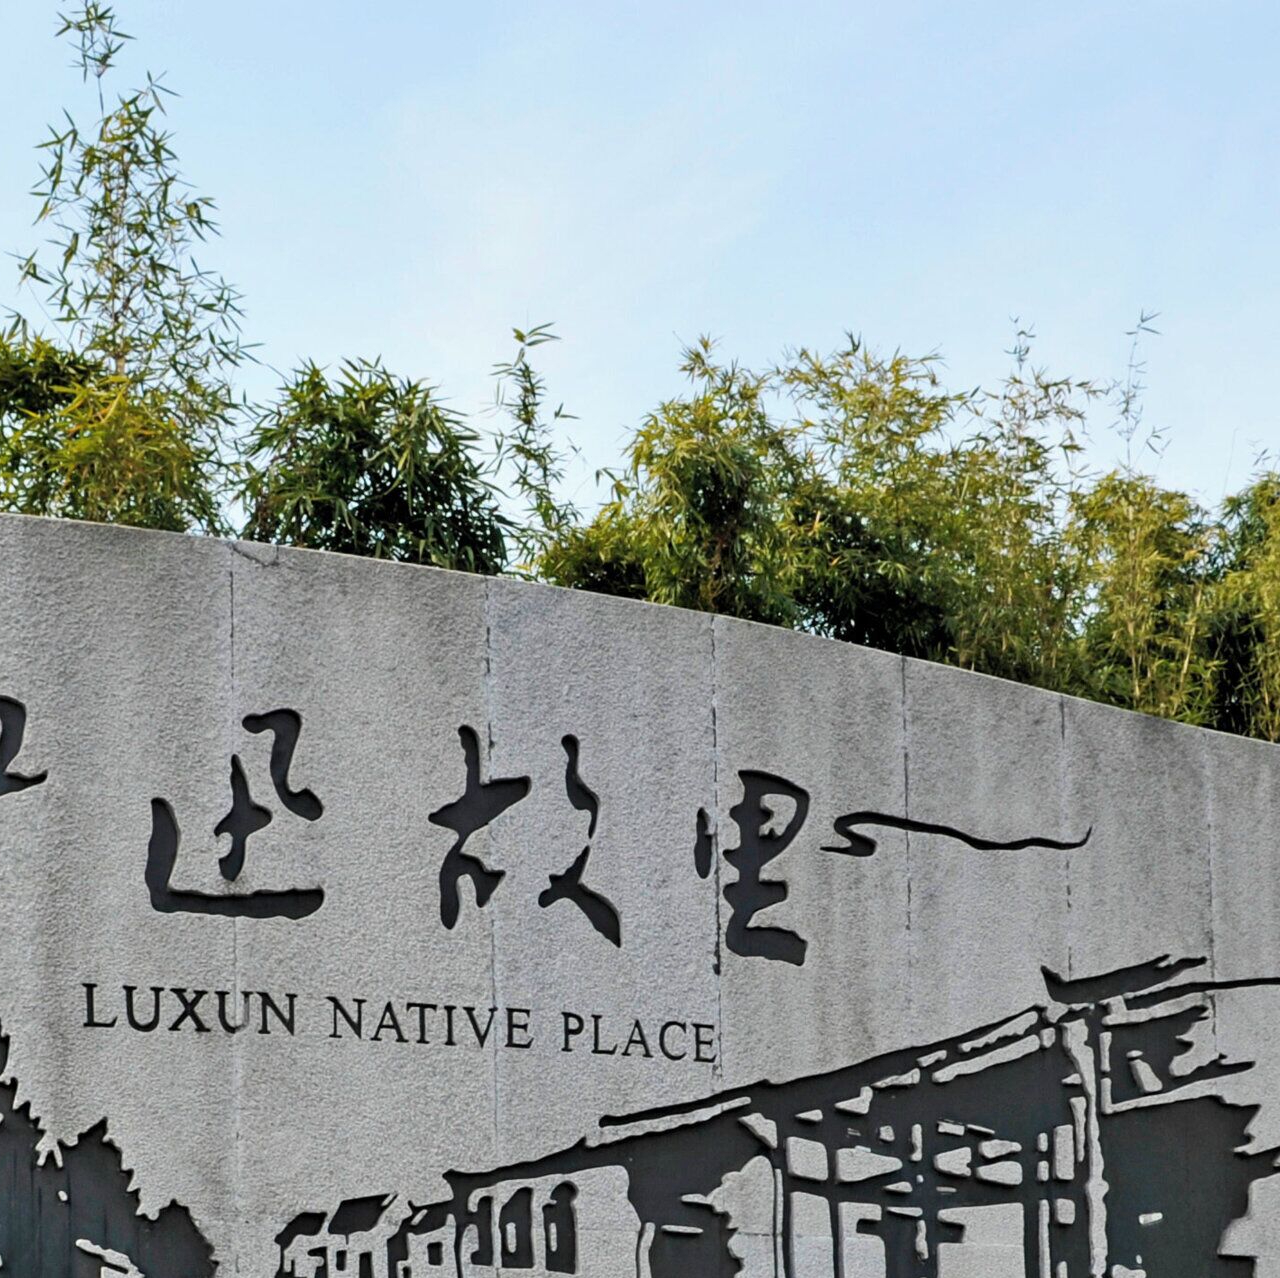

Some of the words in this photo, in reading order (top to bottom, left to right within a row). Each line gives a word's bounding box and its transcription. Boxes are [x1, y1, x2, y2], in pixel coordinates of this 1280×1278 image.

[81, 983, 298, 1036] LUXUN
[326, 996, 535, 1050] NATIVE
[561, 1011, 718, 1064] PLACE
